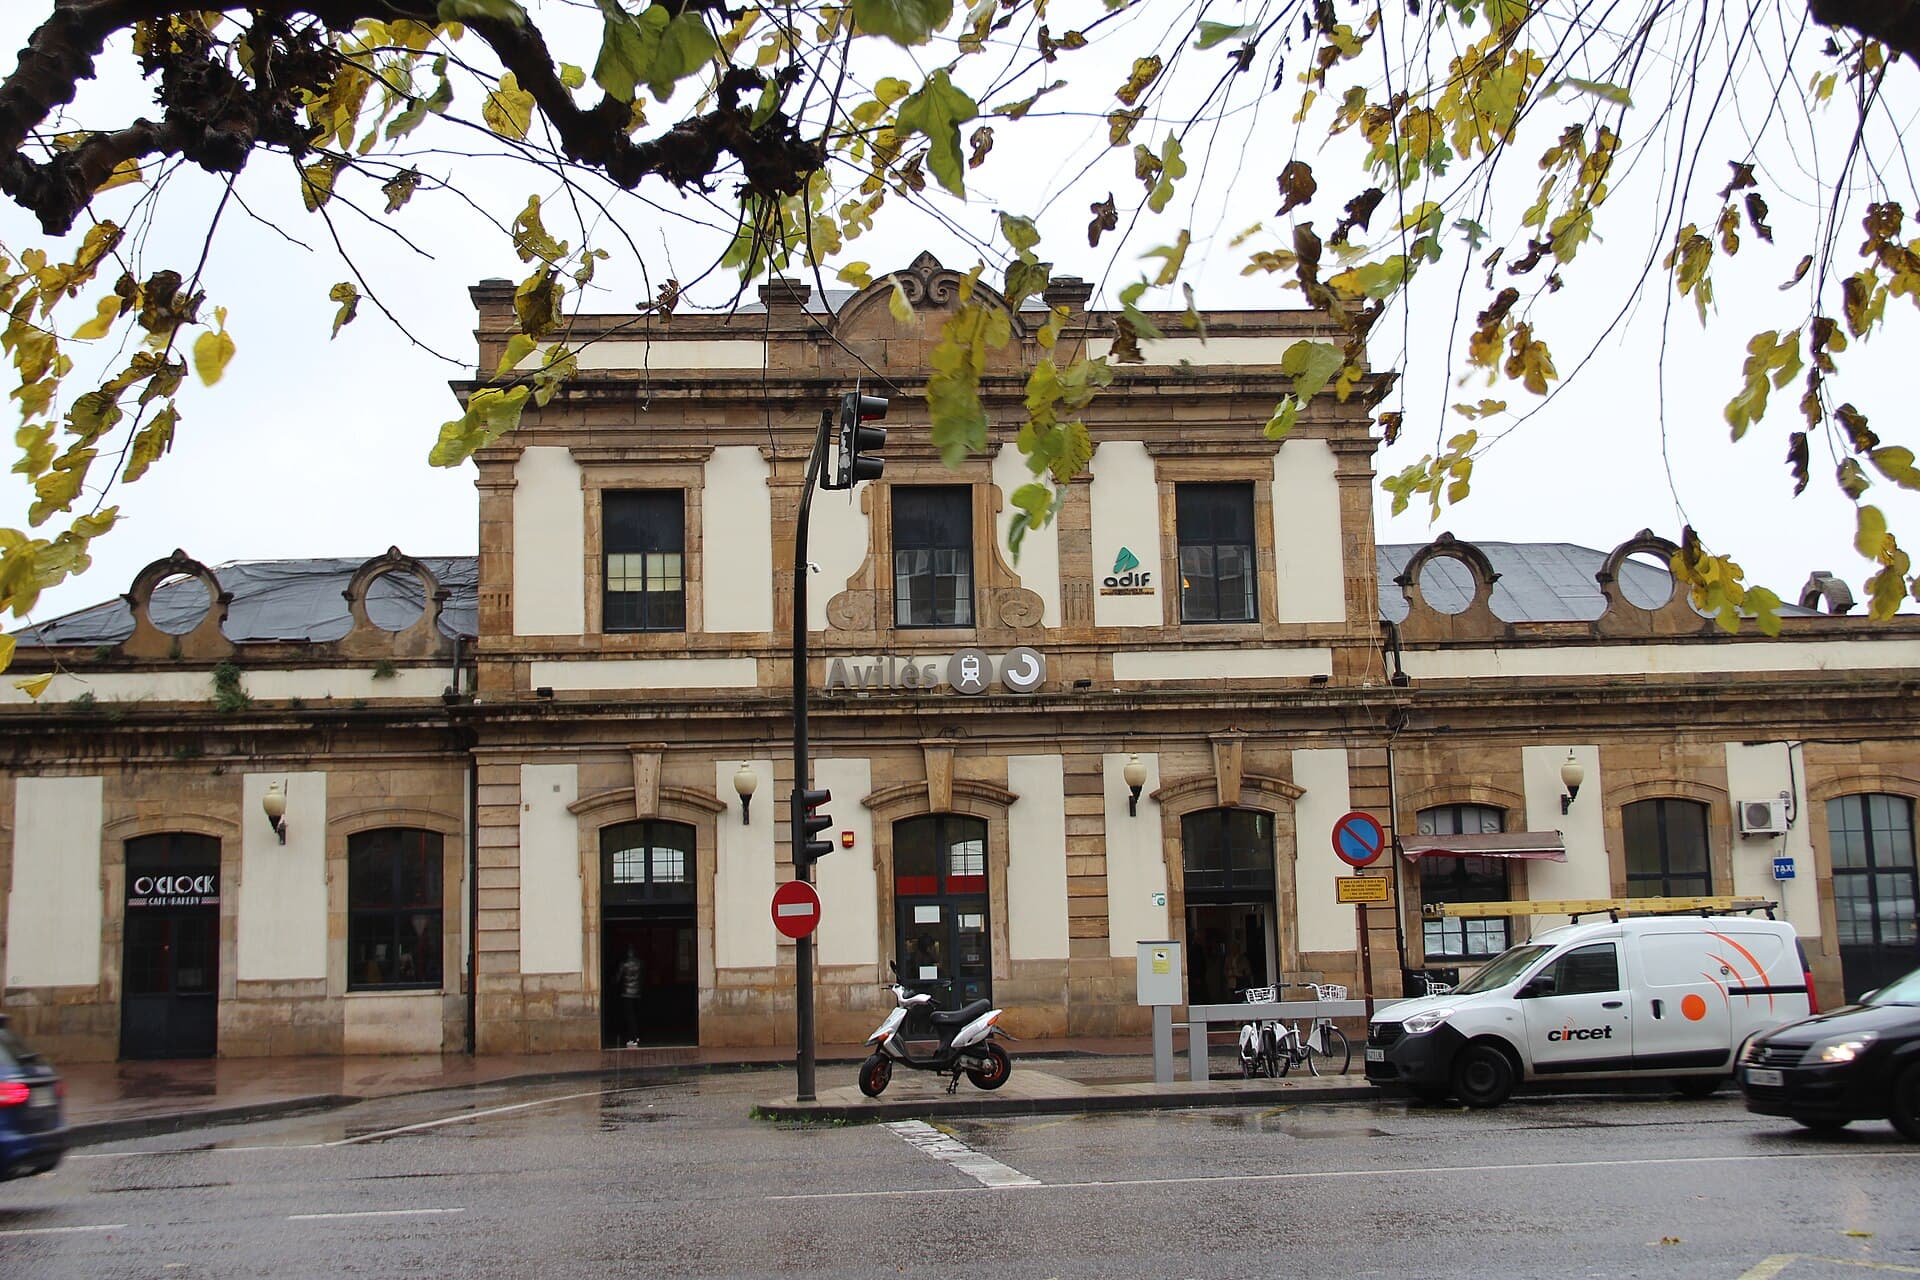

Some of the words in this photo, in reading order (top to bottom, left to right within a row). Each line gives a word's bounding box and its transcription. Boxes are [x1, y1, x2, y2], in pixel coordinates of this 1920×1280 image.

[1103, 572, 1151, 588] adif
[134, 875, 215, 895] O'CLOCK
[1547, 1025, 1612, 1041] circet
